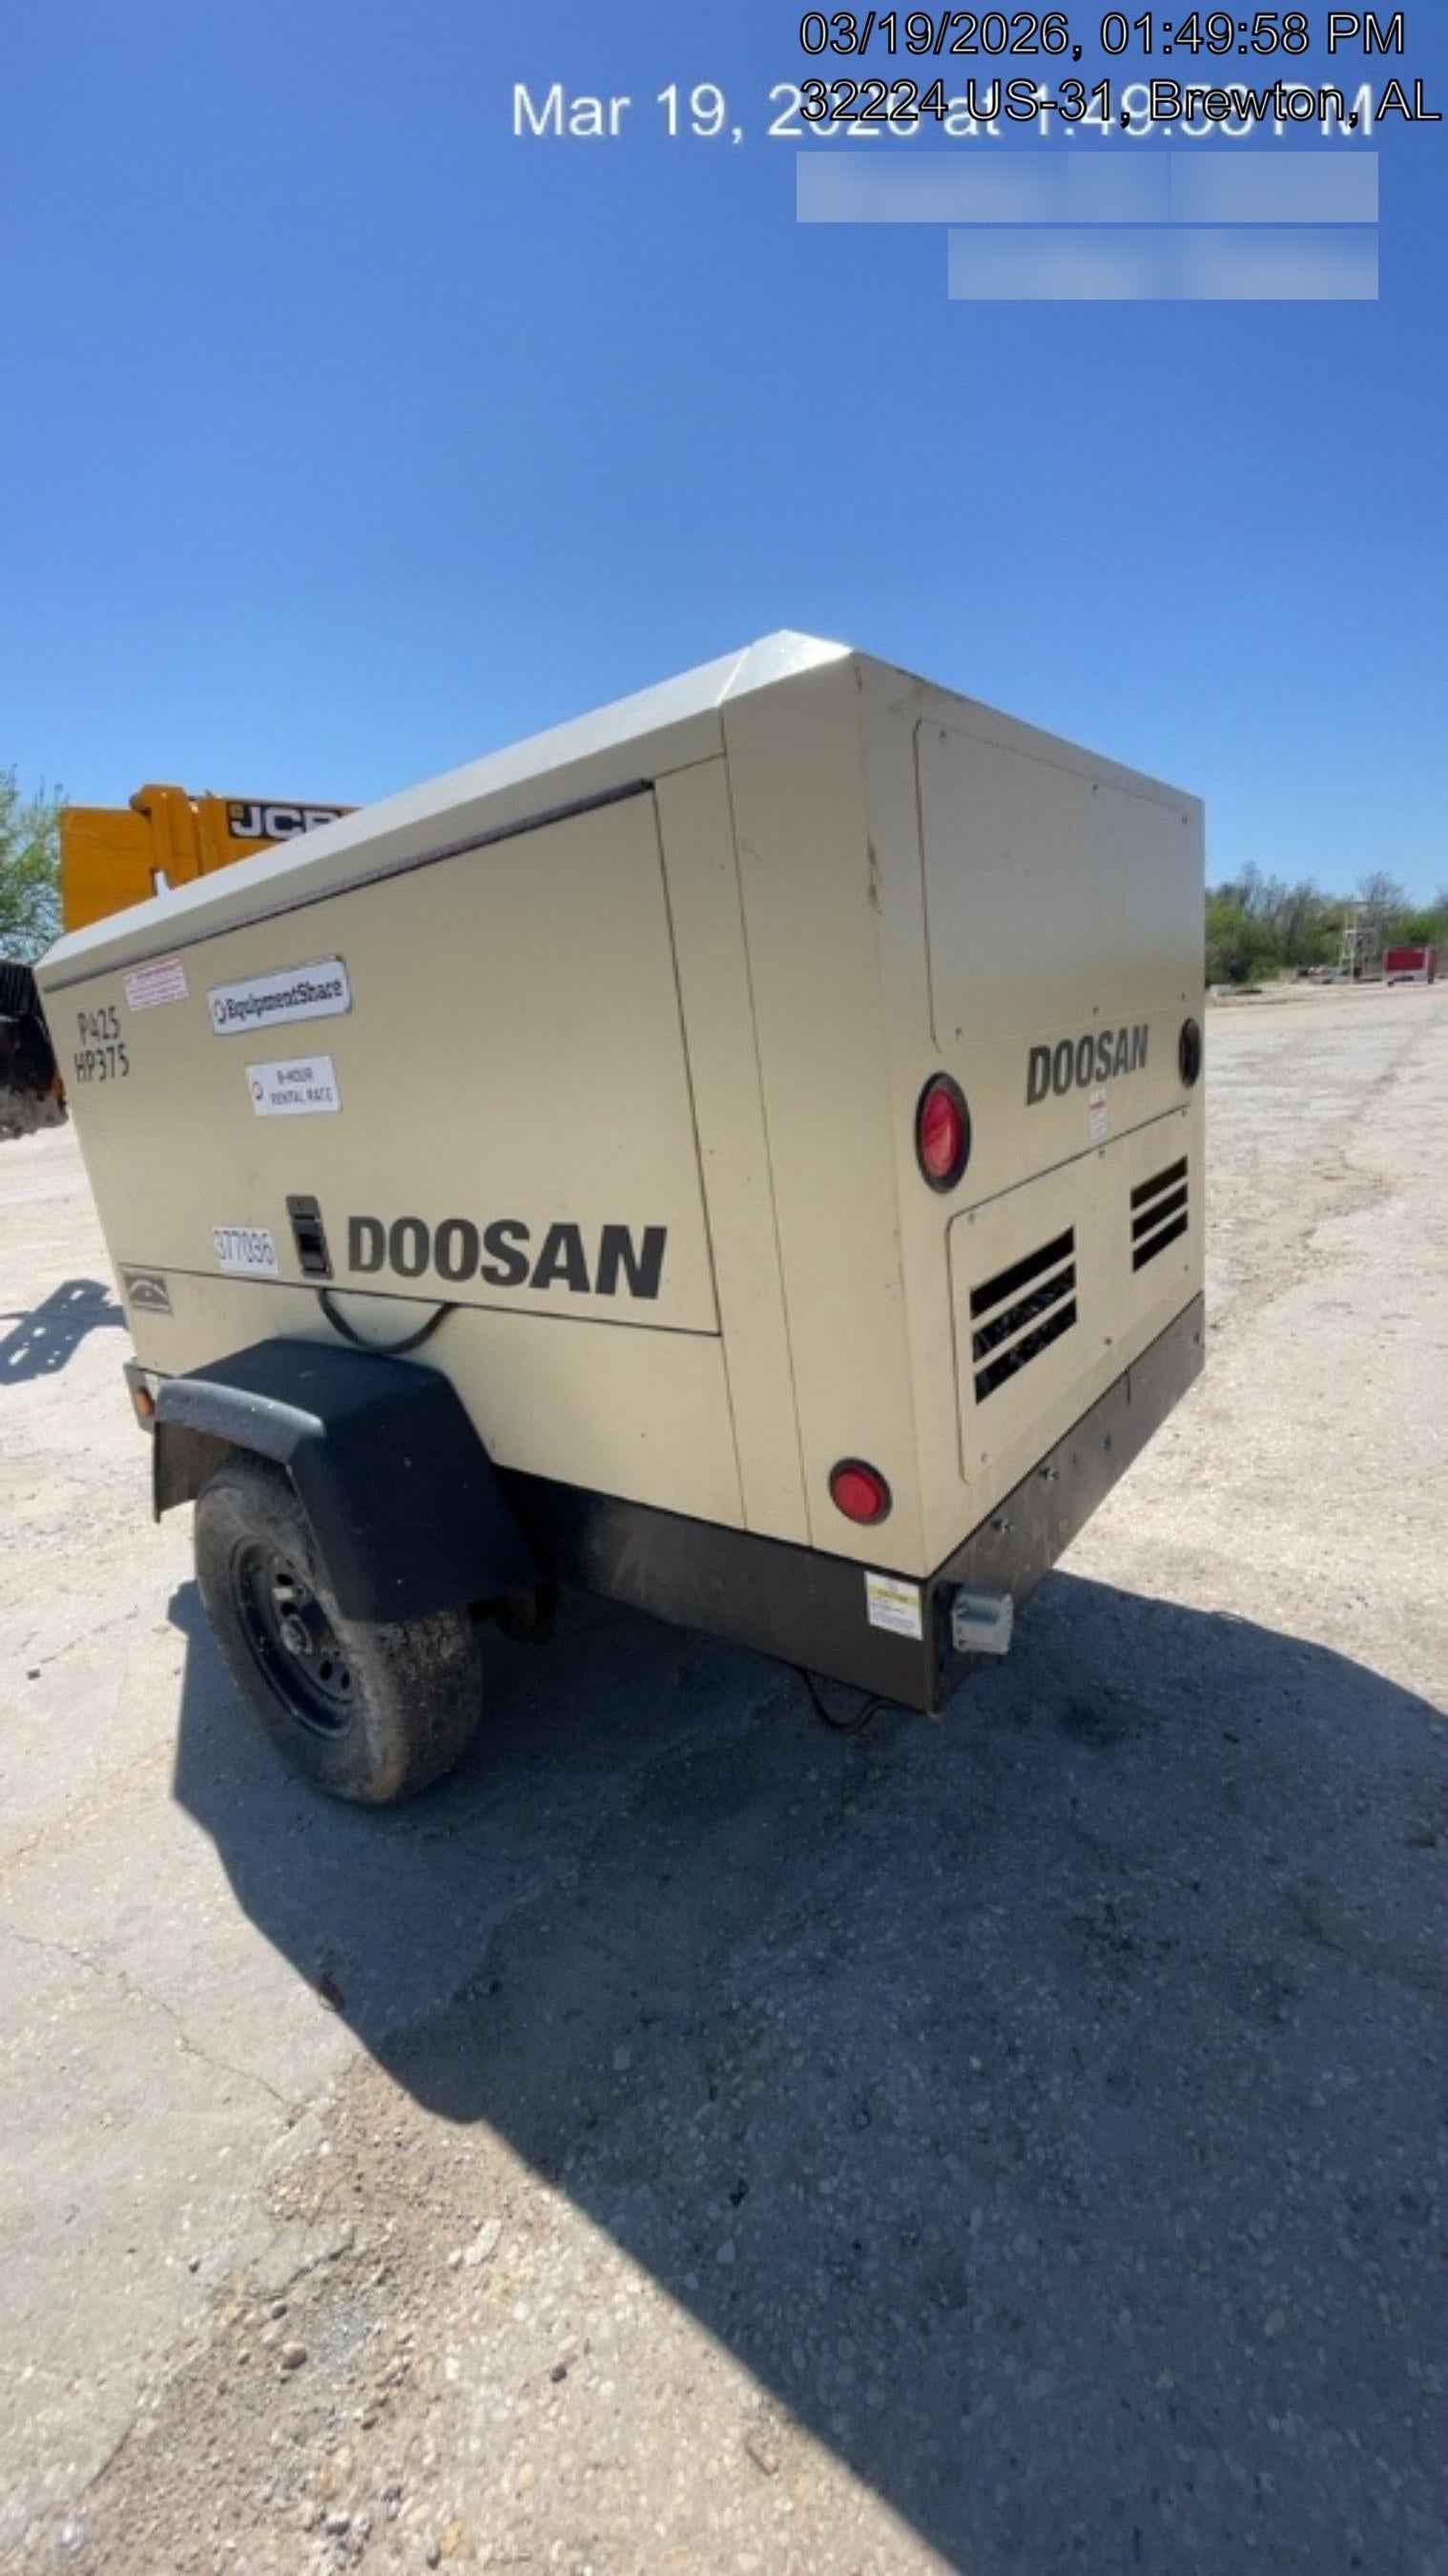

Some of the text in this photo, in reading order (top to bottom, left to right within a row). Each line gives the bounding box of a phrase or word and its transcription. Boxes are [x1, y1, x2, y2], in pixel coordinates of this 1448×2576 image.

[225, 980, 342, 1020] EquipmentShare
[76, 1005, 120, 1046] P425
[74, 1042, 130, 1082] HP375
[1025, 1024, 1148, 1106] DOOSAN
[348, 1216, 667, 1299] DOOSAN
